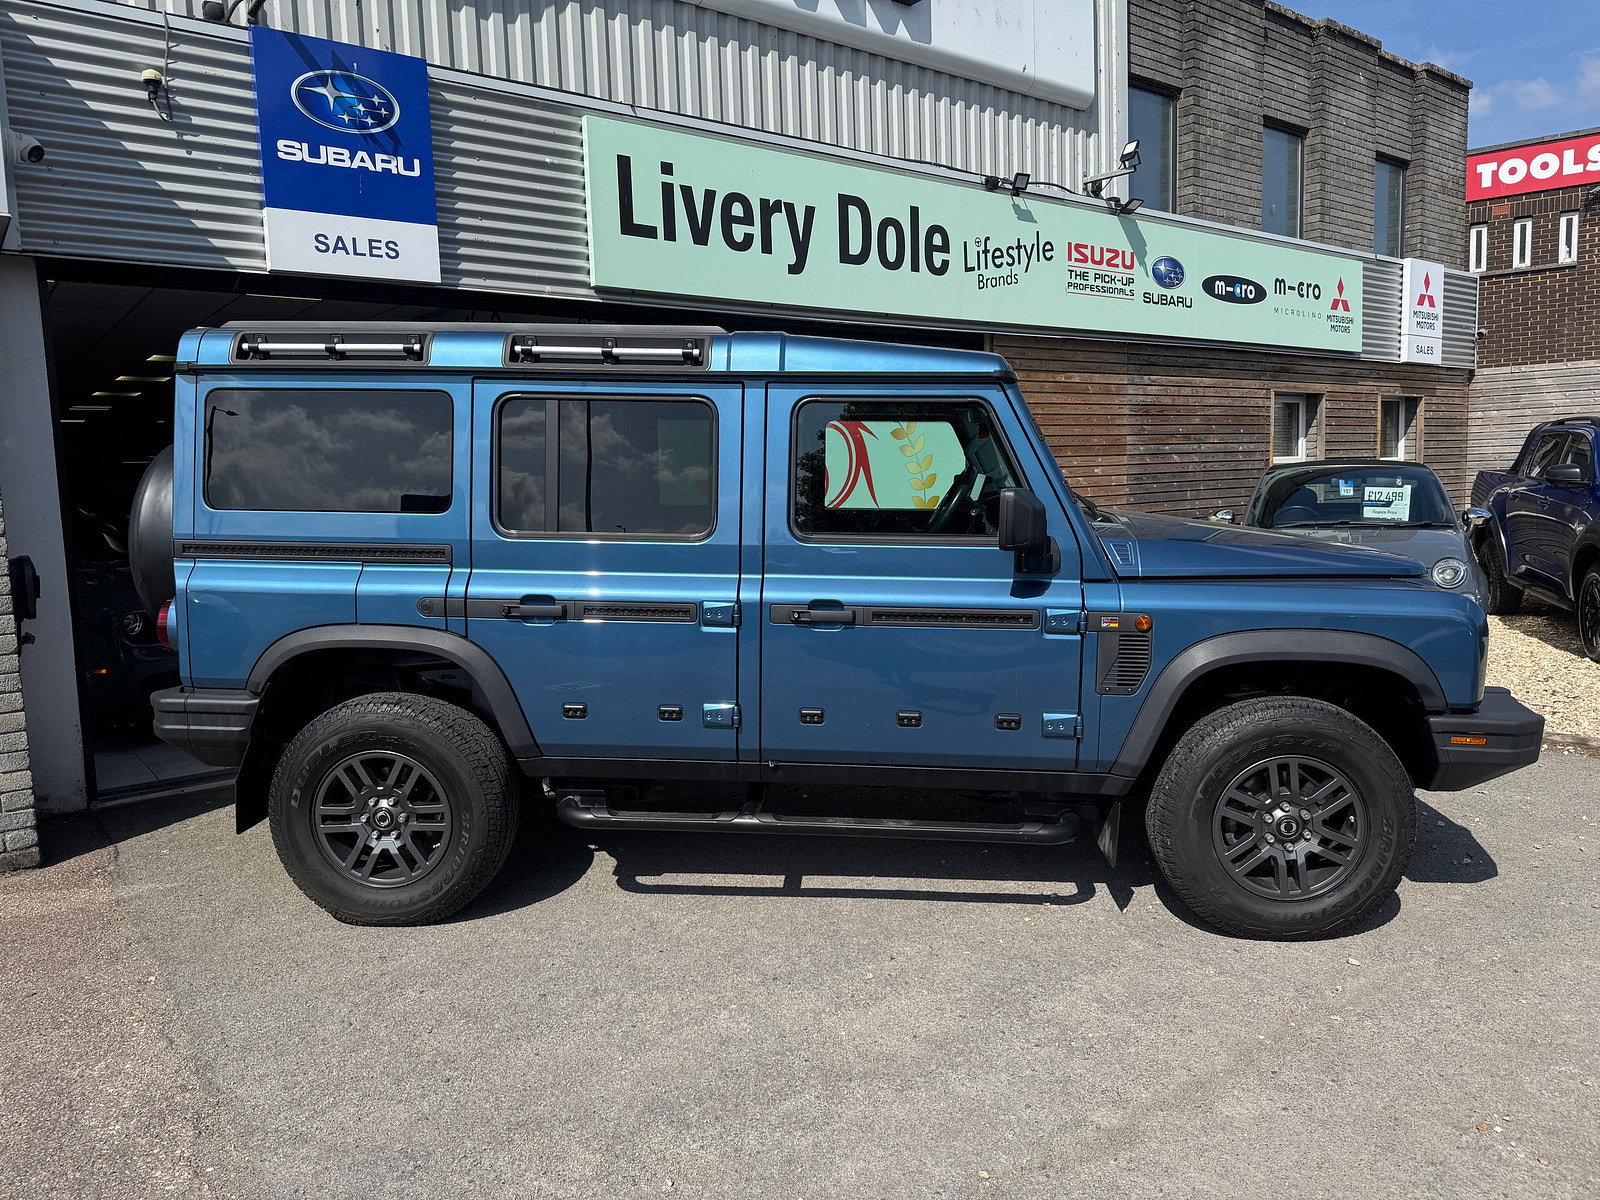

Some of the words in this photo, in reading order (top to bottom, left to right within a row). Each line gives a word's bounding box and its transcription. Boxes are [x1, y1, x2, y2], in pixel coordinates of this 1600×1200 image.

[277, 139, 421, 177] SUBARU
[616, 153, 816, 275] Livery
[837, 192, 950, 276] Dole
[314, 233, 400, 260] SALES
[963, 230, 1055, 273] Lifestyle
[1067, 241, 1135, 270] ISUZU
[977, 268, 1019, 290] Brands
[1067, 269, 1089, 282] THE
[1093, 273, 1135, 287] PICK-UP
[1067, 281, 1135, 297] PROFESSIONALS
[1142, 292, 1193, 308] SUBARU
[1273, 307, 1322, 320] MICROLINO
[1326, 314, 1355, 326] MITSUBISHI
[1413, 310, 1439, 322] MITSUBISHI
[1330, 324, 1351, 334] MOTORS
[1416, 320, 1436, 331] MOTORS
[1415, 344, 1434, 356] SALES
